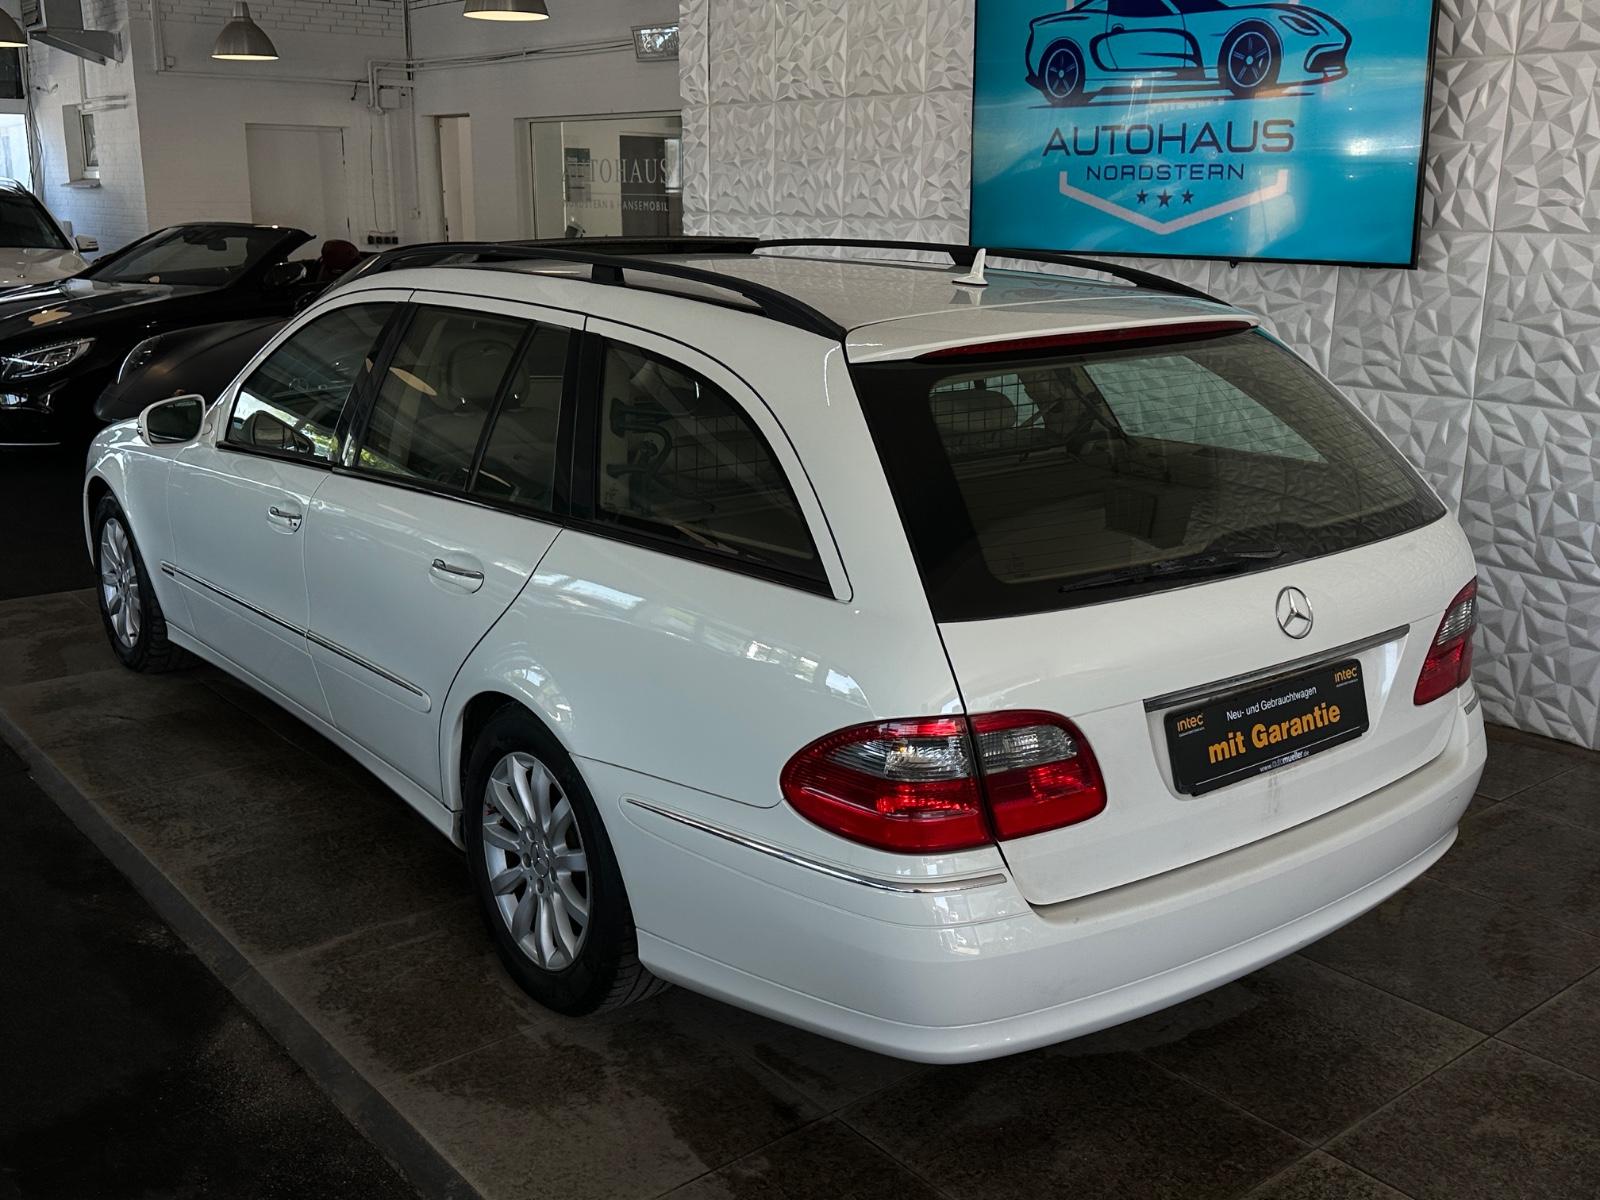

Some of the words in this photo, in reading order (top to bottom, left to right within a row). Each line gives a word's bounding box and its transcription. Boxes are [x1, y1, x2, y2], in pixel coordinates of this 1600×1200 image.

[1043, 119, 1295, 156] AUTOHAUS
[562, 159, 671, 182] TOHAUS
[1086, 163, 1245, 181] NORDSTERN
[1334, 667, 1358, 683] intec
[1226, 709, 1245, 721] Neu-
[1245, 702, 1260, 715] und
[1260, 686, 1317, 711] Gebrauchtwagen
[1176, 713, 1205, 732] intec
[1208, 731, 1246, 764] mit
[1251, 702, 1341, 749] Garantie
